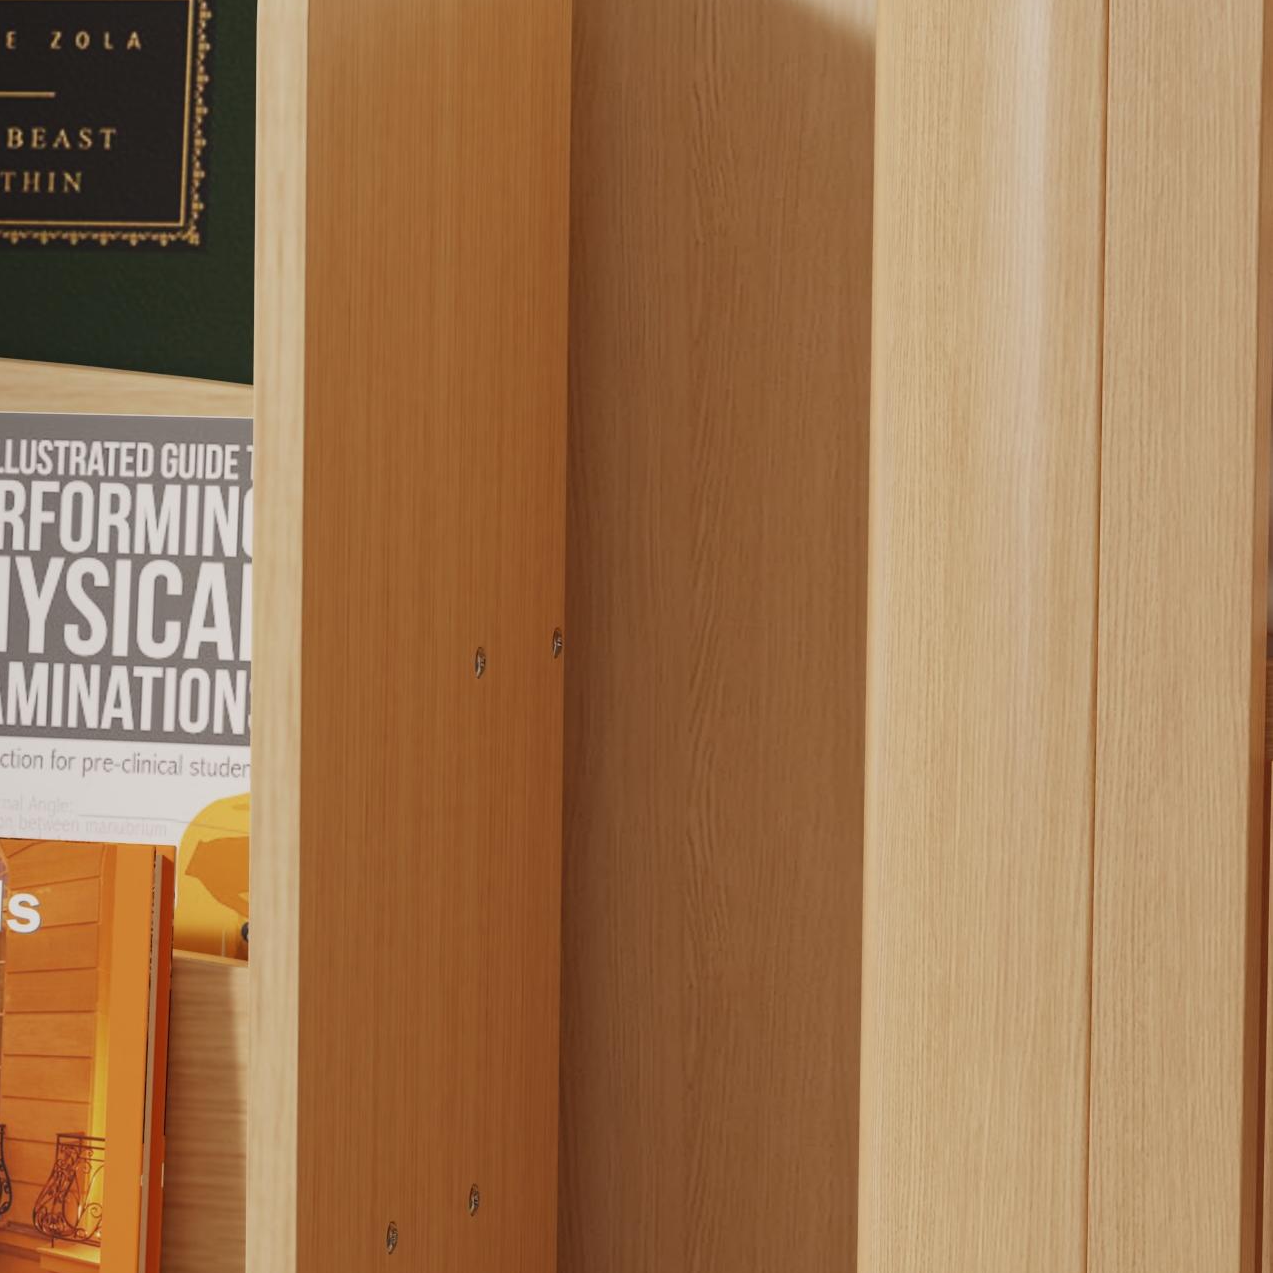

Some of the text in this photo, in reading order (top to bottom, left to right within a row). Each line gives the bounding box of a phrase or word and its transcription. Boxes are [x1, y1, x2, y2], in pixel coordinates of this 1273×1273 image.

[50, 30, 142, 50] ZOLA
[6, 127, 117, 151] BEAST
[161, 442, 239, 480] GUIDE
[50, 748, 75, 771] for
[82, 752, 183, 777] pre-clinical
